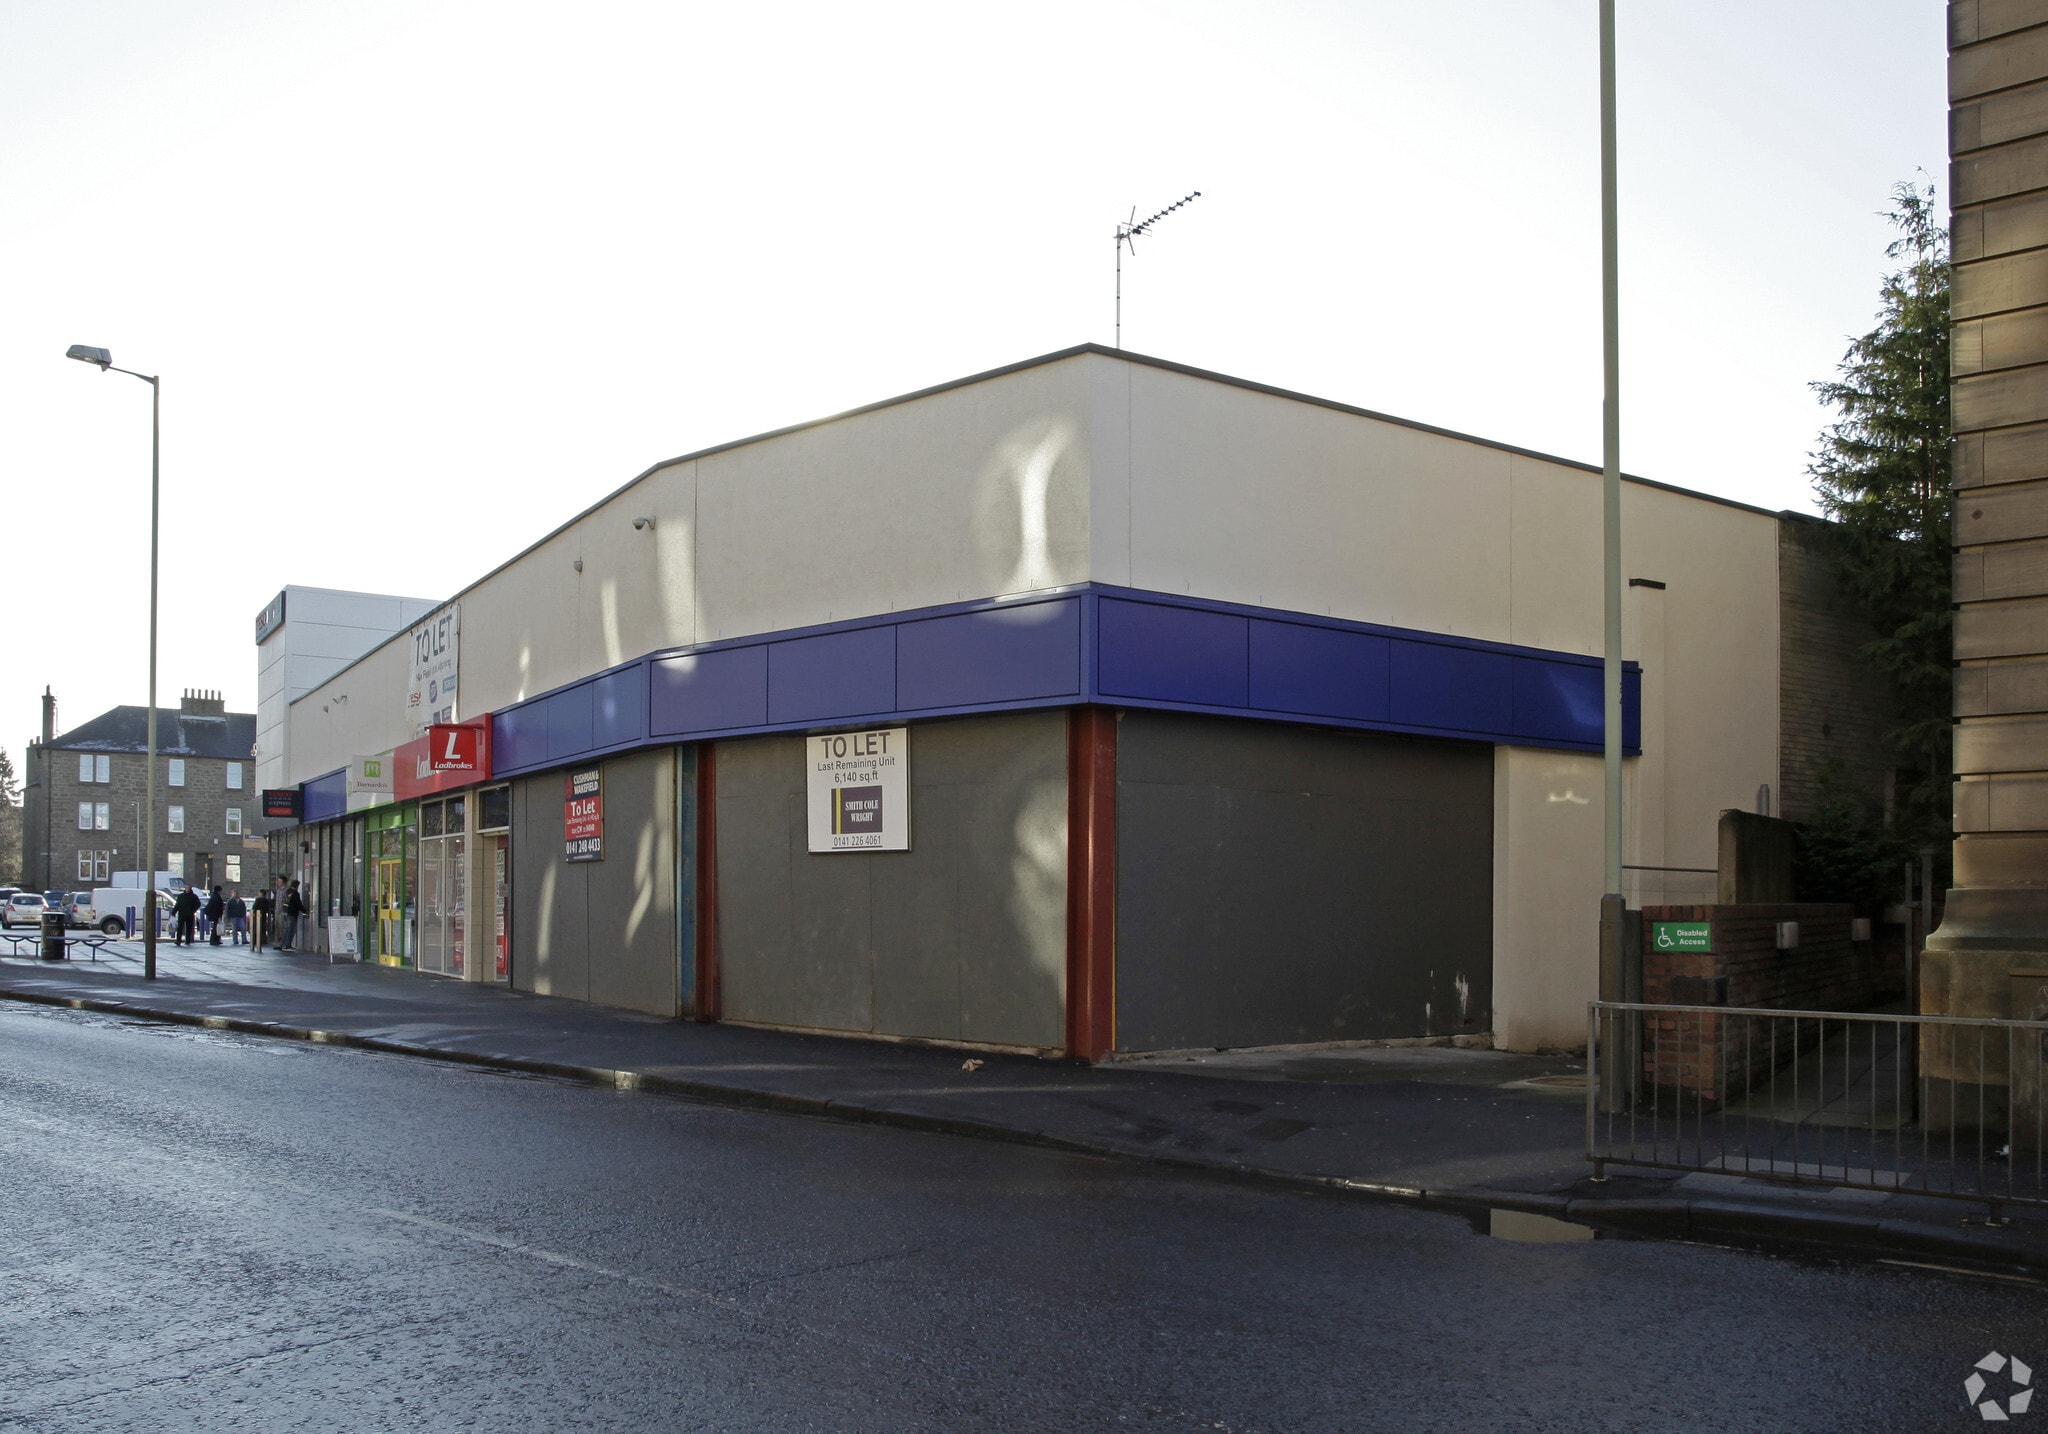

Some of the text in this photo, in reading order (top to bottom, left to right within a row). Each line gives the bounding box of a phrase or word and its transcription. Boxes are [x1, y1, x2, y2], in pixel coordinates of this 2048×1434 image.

[416, 614, 452, 666] TO LET
[444, 731, 461, 759] L
[821, 731, 891, 759] TO LET
[434, 761, 473, 769] Ladbrokes
[818, 756, 895, 771] Last Remaining Unit
[573, 771, 595, 785] CUSHMAN
[834, 770, 879, 784] 6,140 sq.ft
[574, 781, 599, 795] WAKEFIELD
[571, 799, 596, 817] To Let
[845, 799, 879, 811] SMITH COLE
[850, 812, 873, 822] WRIGHT
[566, 841, 578, 854] 0141
[833, 835, 881, 847] 0141 226 4061
[1676, 929, 1708, 937] Disabled
